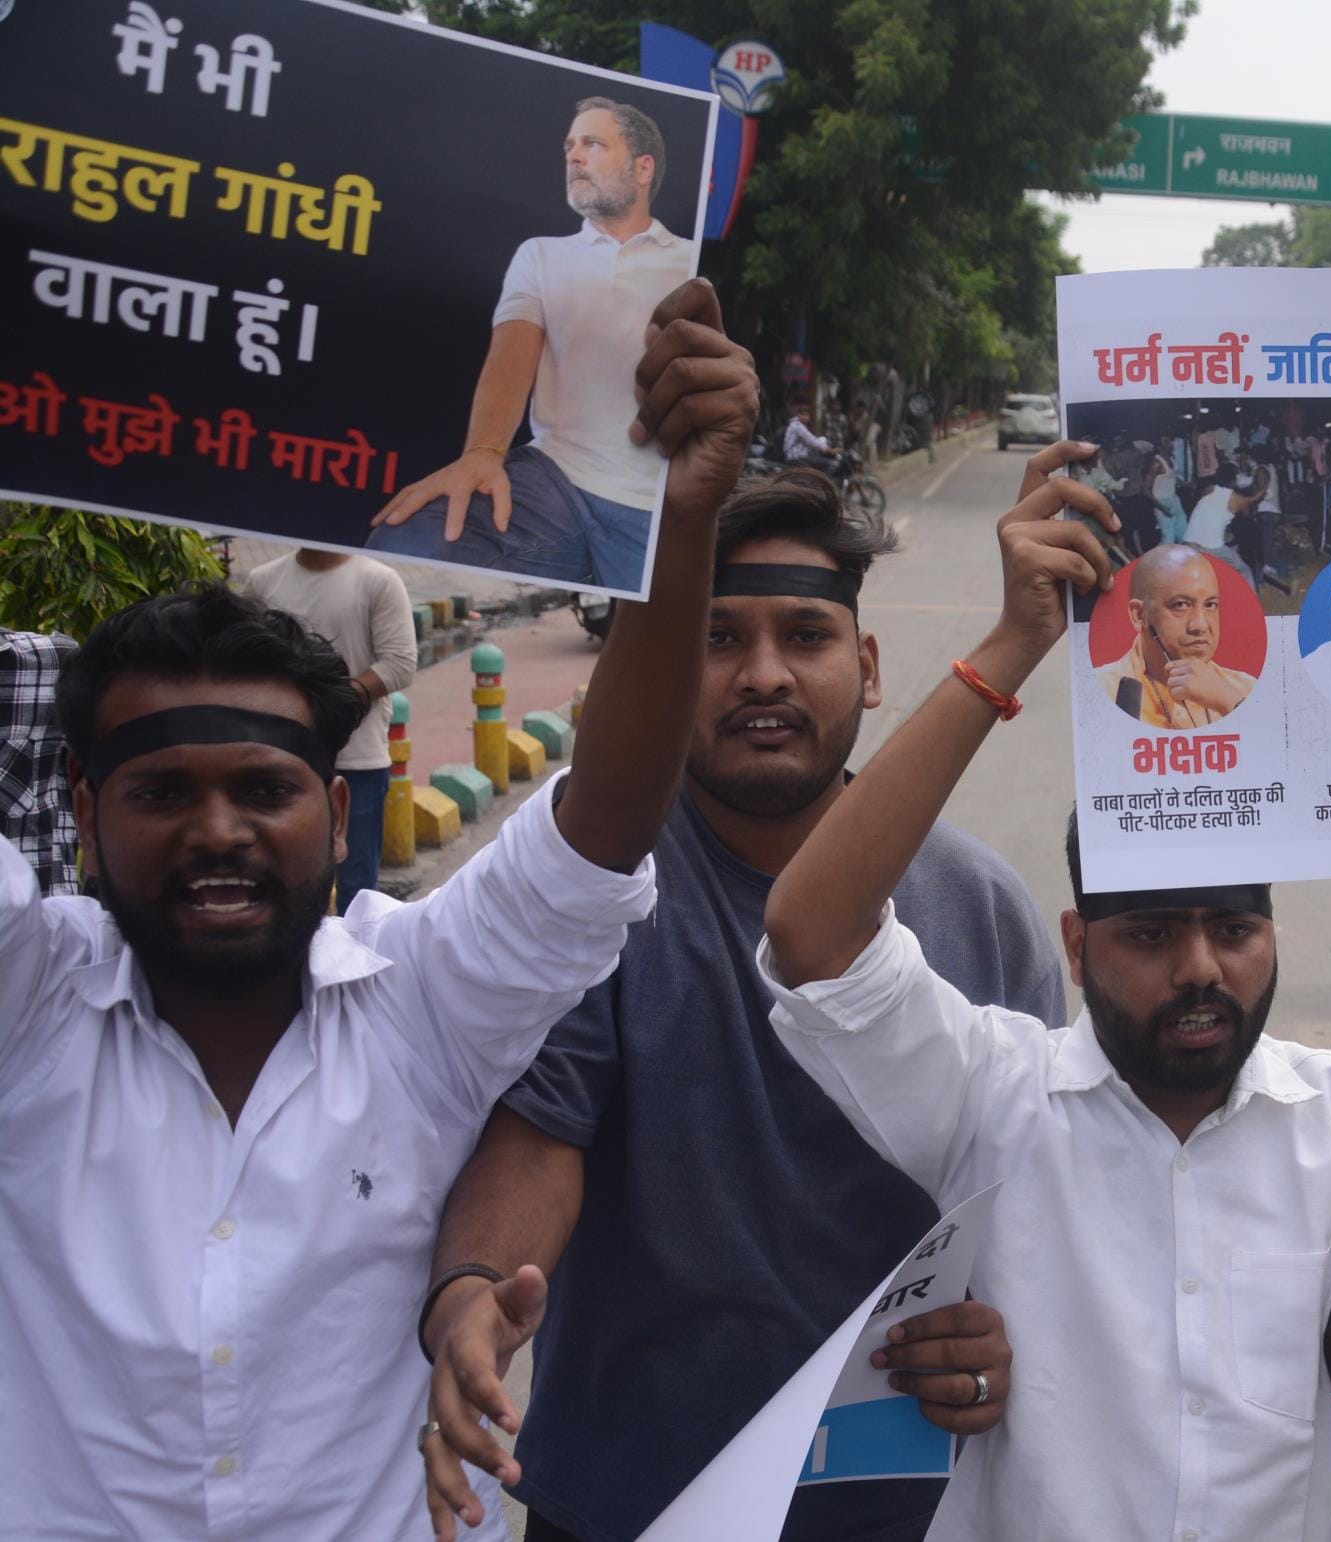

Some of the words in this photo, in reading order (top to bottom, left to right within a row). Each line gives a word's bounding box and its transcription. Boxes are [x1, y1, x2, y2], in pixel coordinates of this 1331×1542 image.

[112, 0, 183, 94] मैं
[194, 33, 282, 117] भी
[734, 49, 772, 73] HP
[1219, 133, 1292, 155] राजभवन
[0, 117, 200, 223] राहुल
[214, 162, 382, 255] गांधी
[1216, 168, 1318, 191] RAJBHAWAN
[28, 249, 219, 342] वाला
[1093, 333, 1161, 386] धर्म
[1168, 332, 1254, 391] नहीं,
[80, 393, 181, 467] मुझे
[192, 408, 257, 470] भी
[268, 428, 398, 493] मारो।
[1132, 734, 1240, 776] भक्षक
[1092, 795, 1123, 811] बाबा
[1127, 788, 1164, 810] वालों
[1165, 787, 1180, 808] ने
[1183, 786, 1223, 807] दलित
[1226, 788, 1262, 810] युवक
[1265, 782, 1285, 803] की
[1119, 810, 1197, 832] पीट-पीटकर
[1200, 812, 1233, 829] हत्या
[1235, 805, 1261, 826] की!
